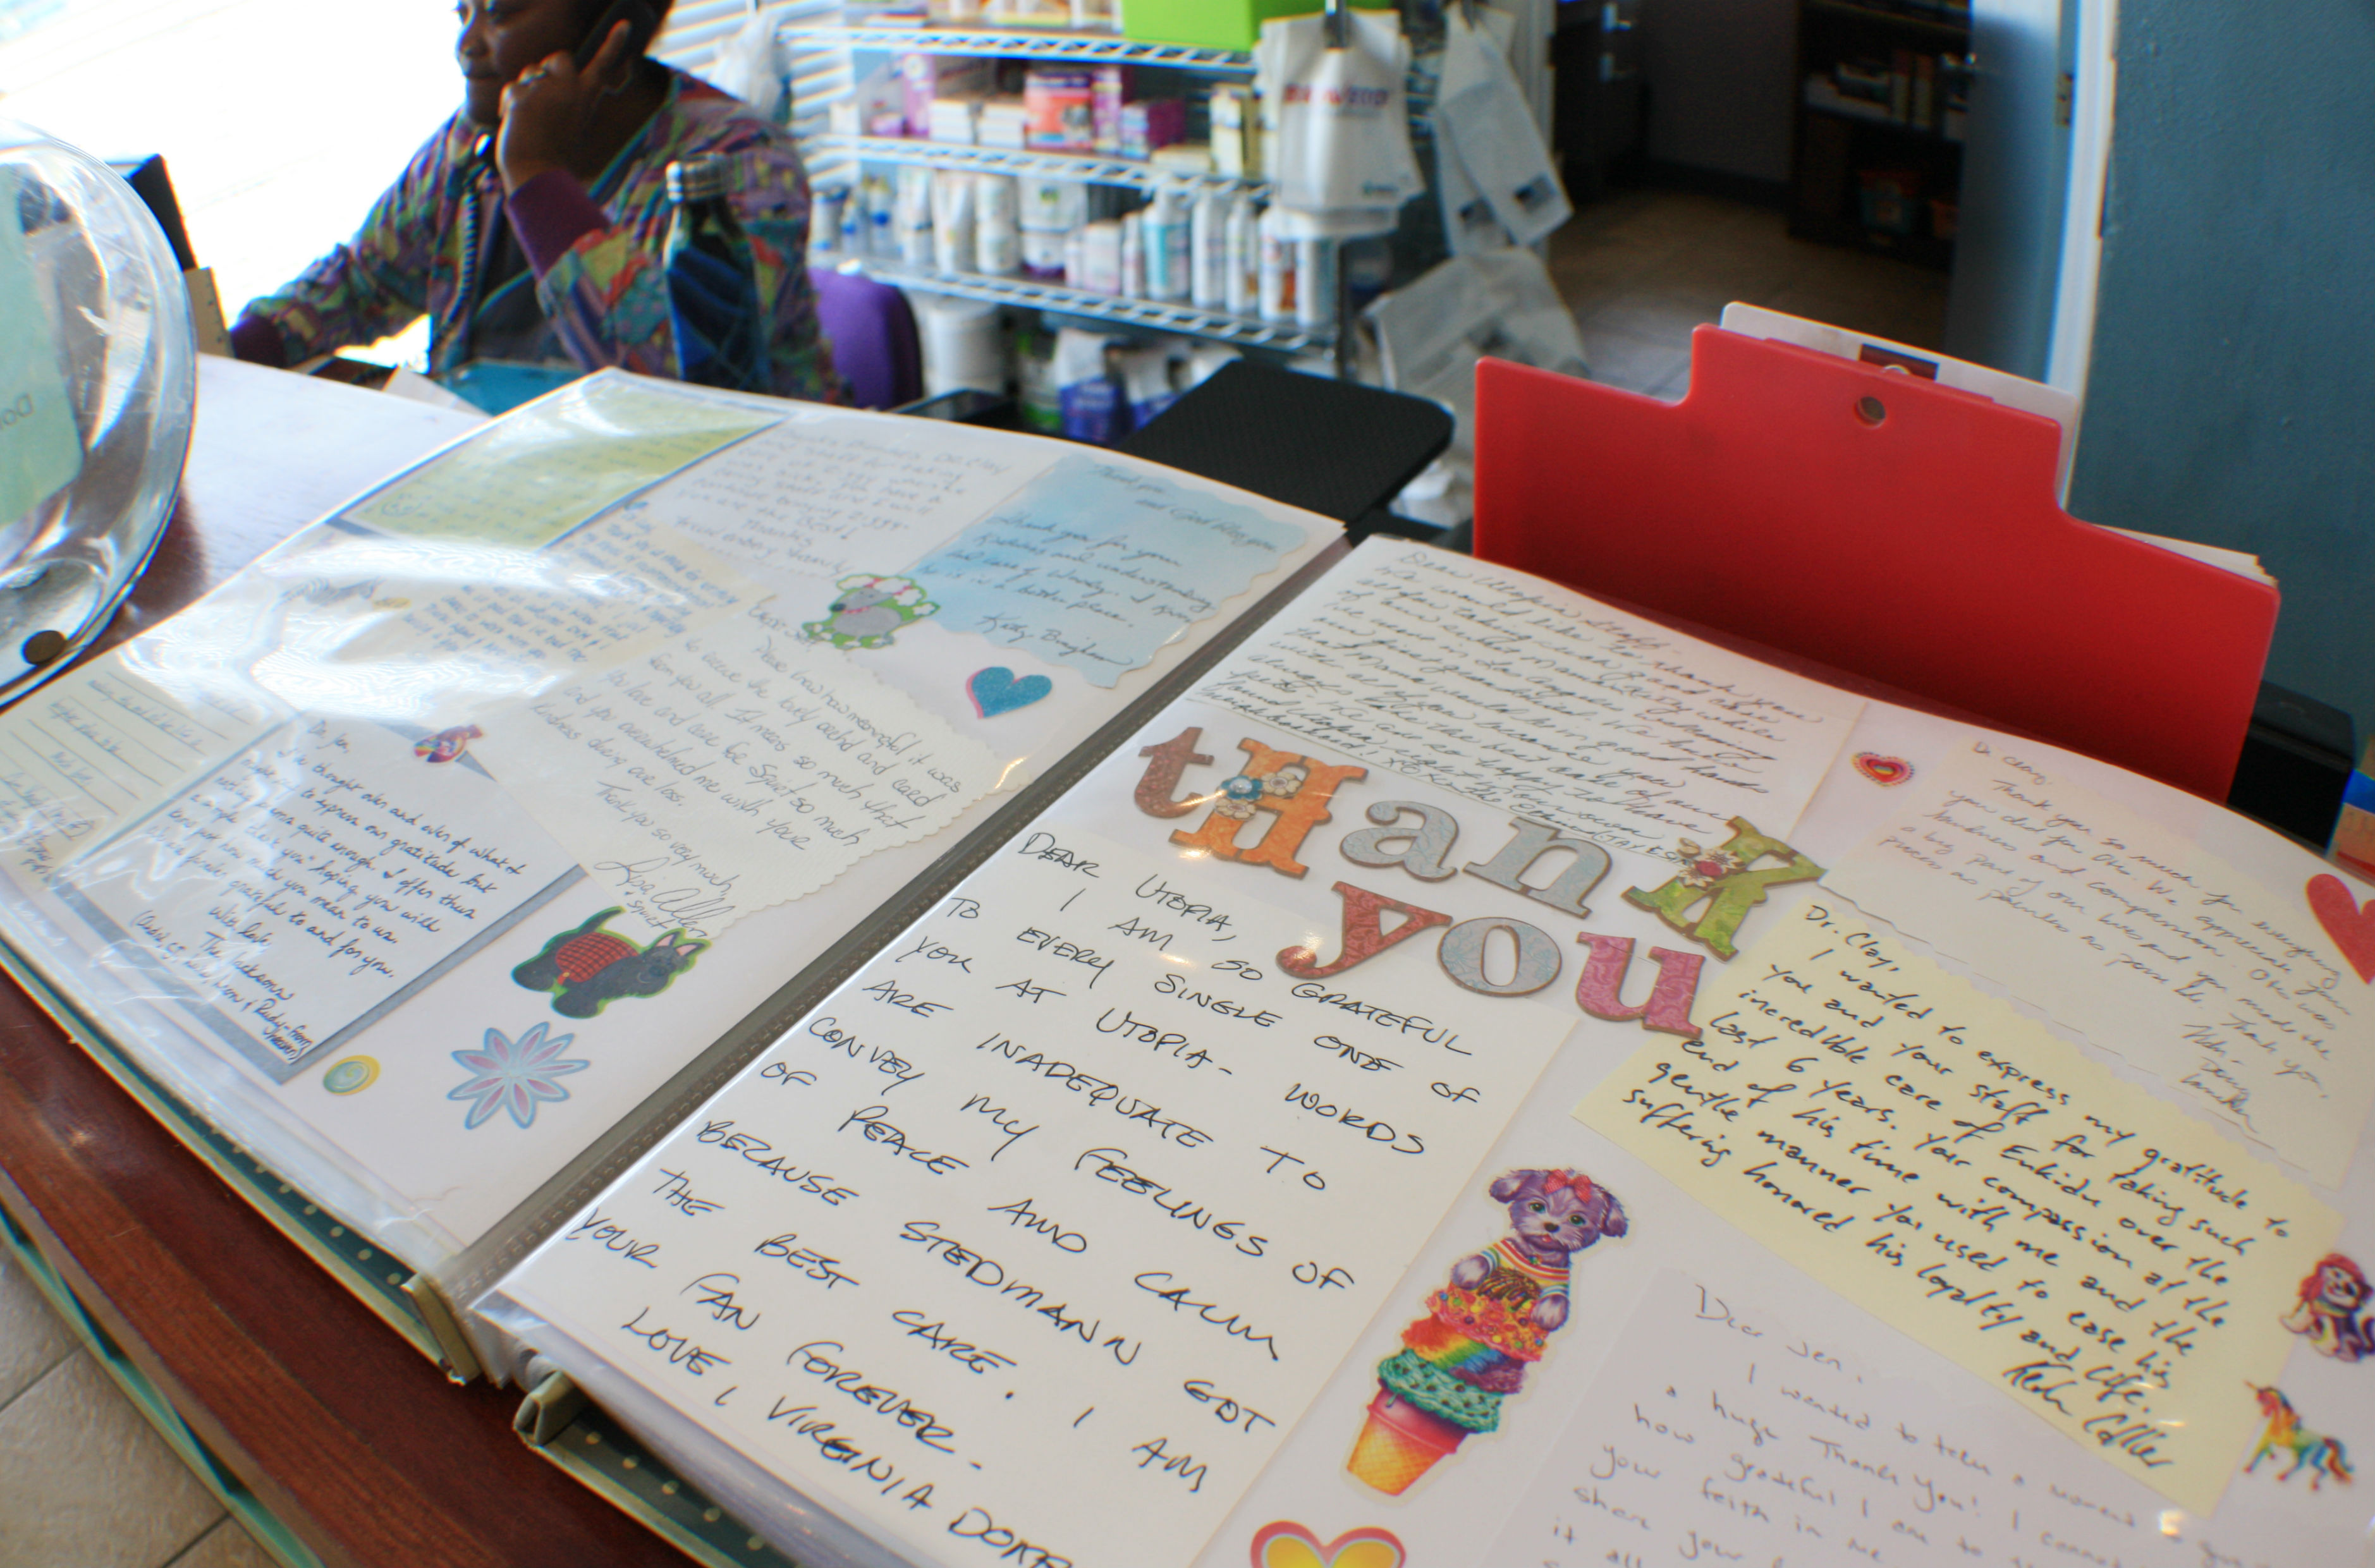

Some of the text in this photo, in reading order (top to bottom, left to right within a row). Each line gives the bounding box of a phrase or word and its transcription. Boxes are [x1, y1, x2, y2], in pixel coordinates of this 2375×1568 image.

[789, 796, 815, 815] so
[813, 815, 870, 847] much
[793, 755, 817, 772] so
[817, 769, 875, 801] much
[855, 752, 898, 776] and
[926, 766, 962, 793] was
[1018, 832, 1237, 943] DEAR UTOPIA,
[1059, 887, 1472, 1056] I AM SO GRATEFUL
[1275, 880, 1705, 1039] you
[947, 897, 980, 918] TO
[1017, 926, 1115, 990] EVERY
[1155, 974, 1283, 1030] SINGLE
[1314, 1035, 1405, 1071] ONE
[995, 978, 1066, 1004] AT
[1285, 1082, 1424, 1153] WORDS
[809, 1017, 1354, 1290] CONVEY MY FEELINGS OF
[862, 980, 1326, 1189] ARE INADEQUATE TO
[1709, 1011, 1778, 1043] last
[1786, 1057, 1819, 1074] 6
[1983, 1176, 2134, 1270] compassion
[2144, 1271, 2189, 1294] at
[2183, 1296, 2230, 1327] the
[1738, 989, 1865, 1063] incredible
[1884, 1074, 1942, 1110] care
[1953, 1119, 2005, 1143] of
[2118, 1217, 2180, 1251] over
[2185, 1256, 2229, 1286] the
[1809, 949, 2289, 1237] I wanted to express my gratitude to
[1824, 999, 1884, 1028] and
[1969, 1083, 2049, 1125] staff
[2051, 1134, 2095, 1158] for
[2108, 1172, 2184, 1226] taking
[2189, 1218, 2256, 1256] such
[565, 1208, 658, 1268] YOUR
[680, 1273, 760, 1329] FAN
[697, 1121, 859, 1206] BECAUSE
[1184, 1380, 1276, 1433] GOT
[761, 1062, 1278, 1361] OF PEACE AND CALM
[1622, 1088, 1730, 1167] suffering
[1743, 1161, 1855, 1232] honored
[1865, 1232, 1907, 1267] his
[1917, 1264, 2025, 1329] loyalty
[2020, 1329, 2081, 1362] and
[1647, 1062, 1740, 1122] gentle
[1757, 1129, 1871, 1194] manner
[1932, 1232, 2009, 1272] used
[2017, 1280, 2048, 1300] to
[2067, 1311, 2125, 1353] ease
[2135, 1351, 2171, 1389] his
[1681, 1038, 2197, 1356] end of his time with me and the
[653, 1167, 726, 1215] THE
[755, 1234, 859, 1289] BEST
[1074, 1407, 1094, 1428] I
[1132, 1438, 1206, 1492] AM
[1634, 1403, 1694, 1443] how
[767, 1396, 935, 1509] VIRGINIA
